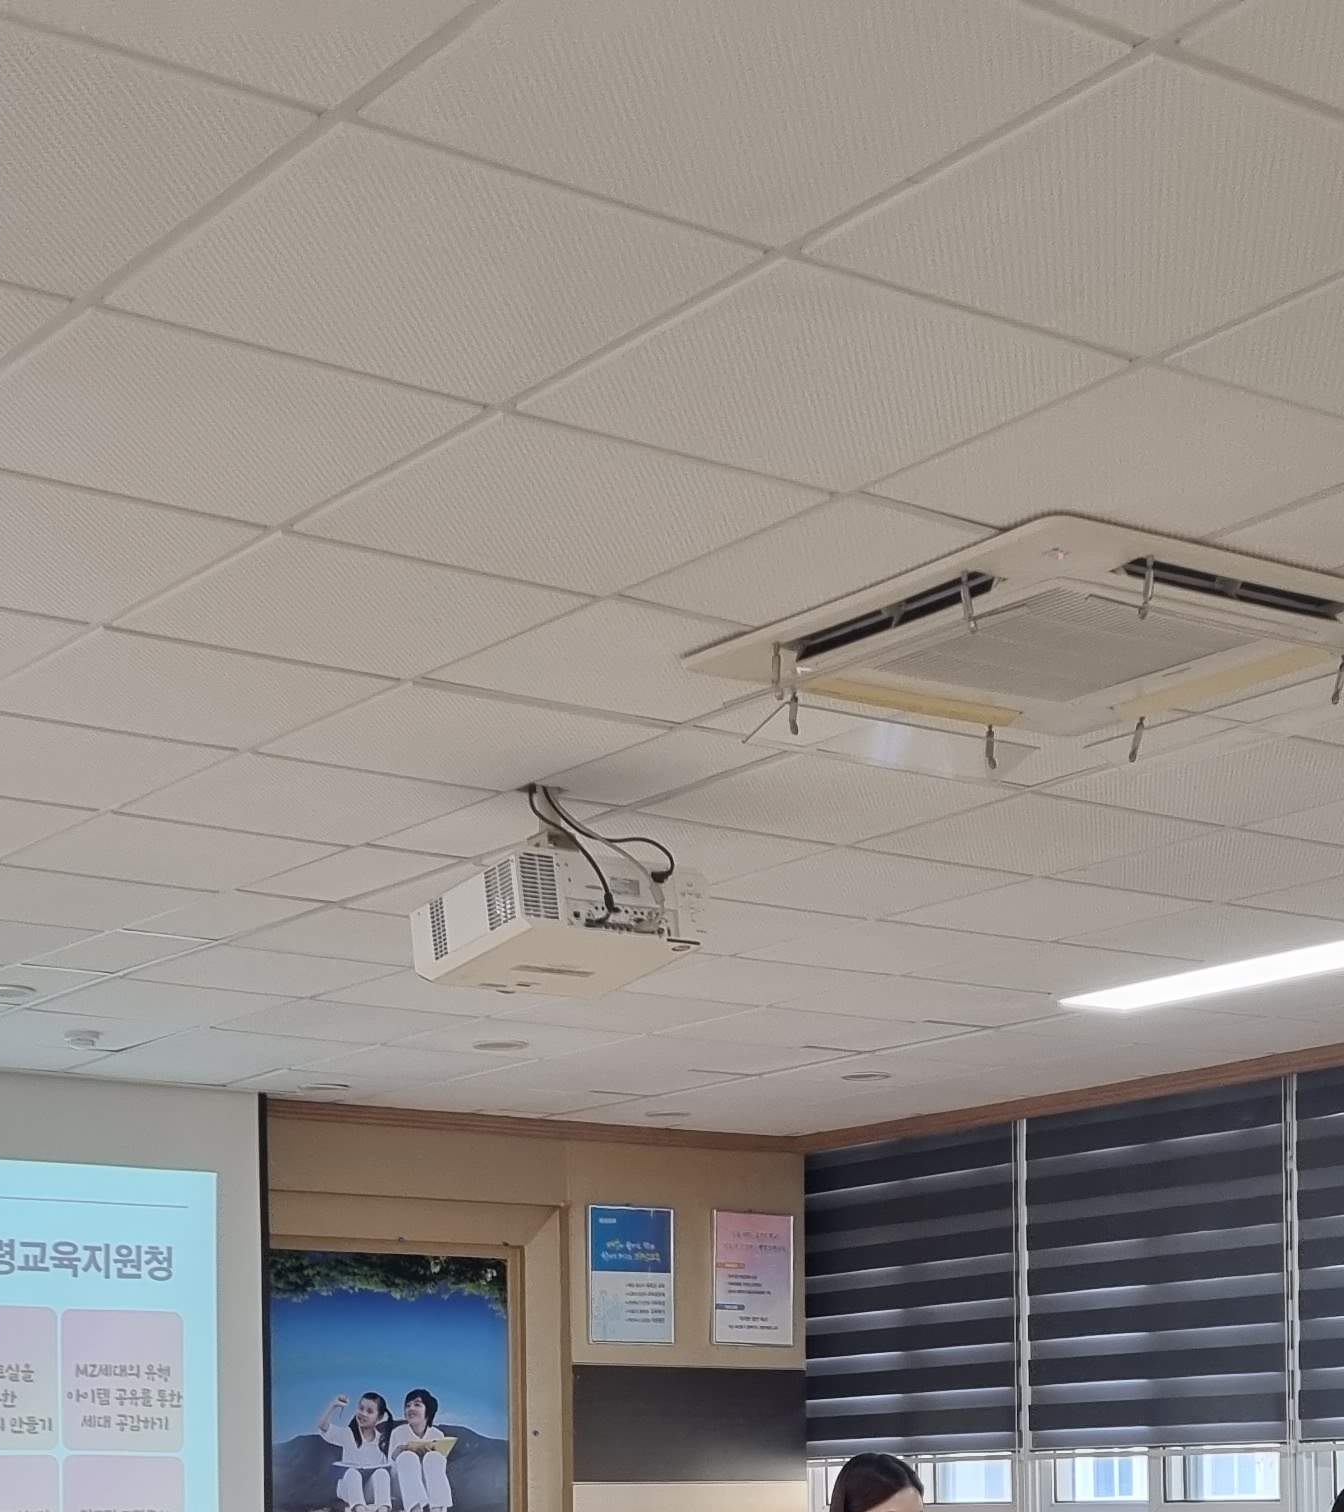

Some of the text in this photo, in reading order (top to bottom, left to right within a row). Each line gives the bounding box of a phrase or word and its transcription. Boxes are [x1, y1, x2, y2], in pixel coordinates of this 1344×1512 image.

[74, 1363, 171, 1382] MZ세대의 유행
[67, 1388, 183, 1409] 아이템 공유를 통한
[9, 1416, 53, 1435] 만들기
[81, 1414, 169, 1432] 세대 공감하기
